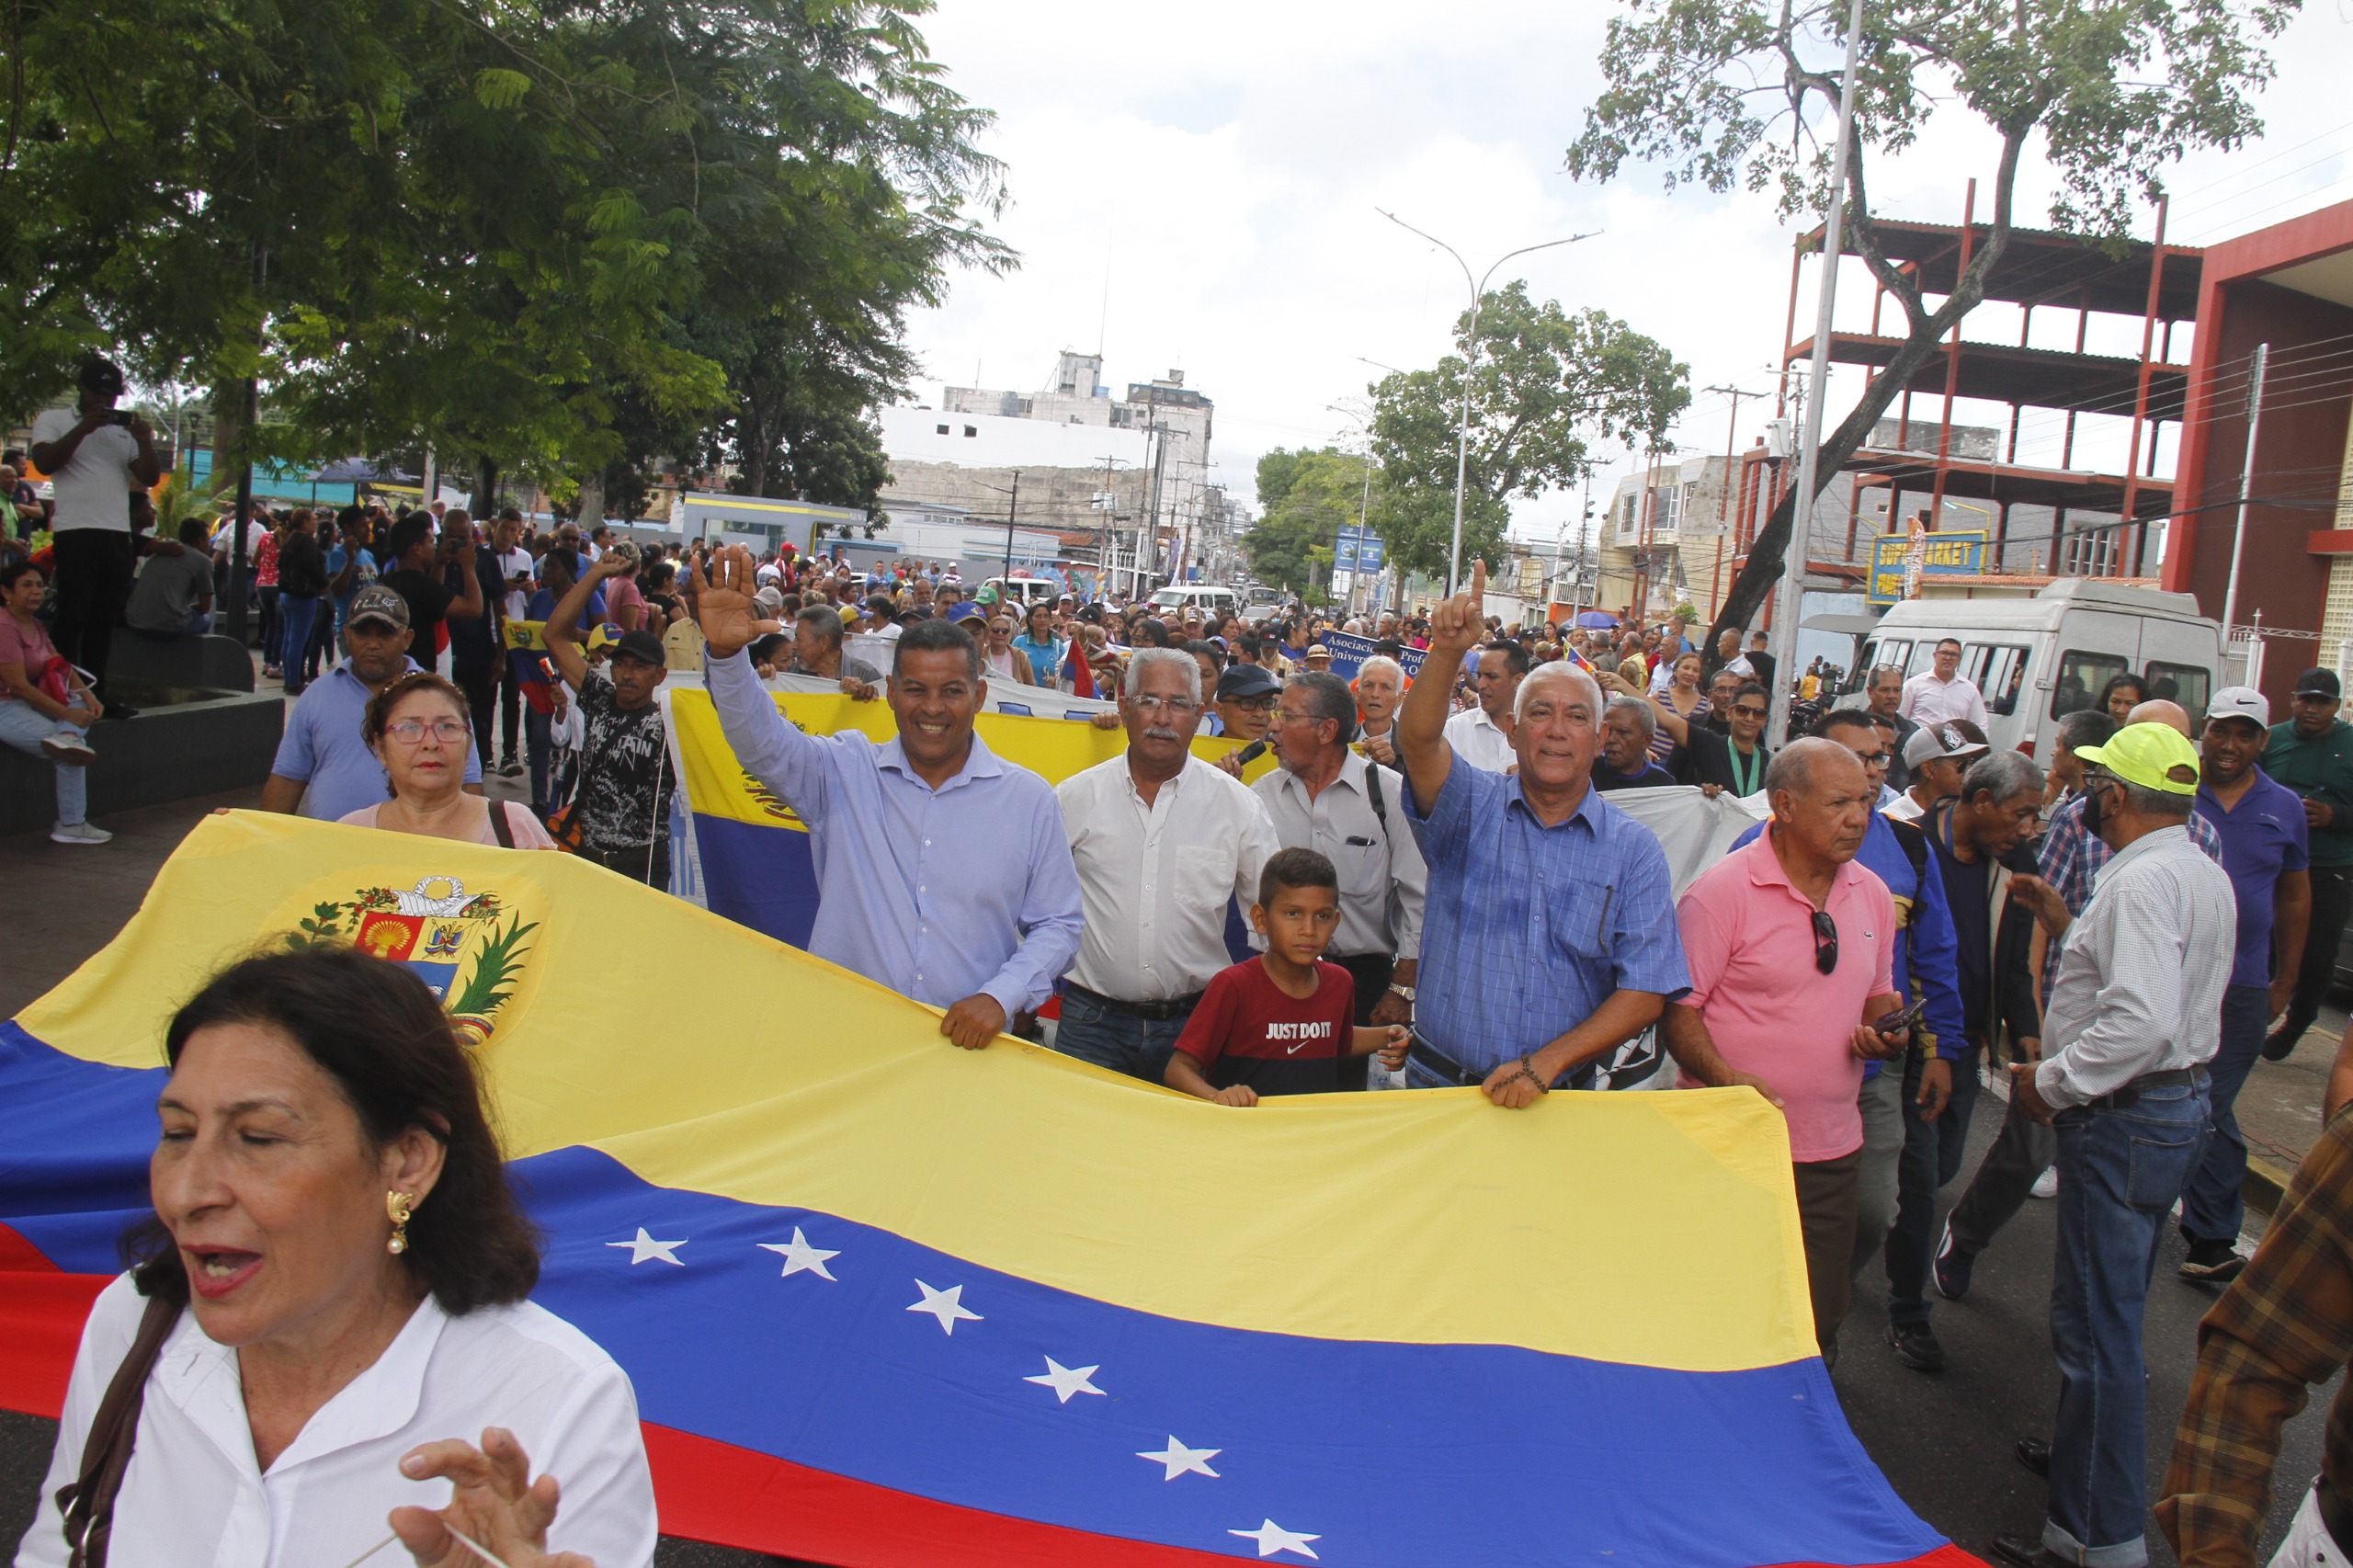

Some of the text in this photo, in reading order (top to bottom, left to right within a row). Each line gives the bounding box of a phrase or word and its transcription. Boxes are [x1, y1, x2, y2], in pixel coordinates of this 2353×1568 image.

[1266, 1021, 1332, 1040] JUST DO IT
